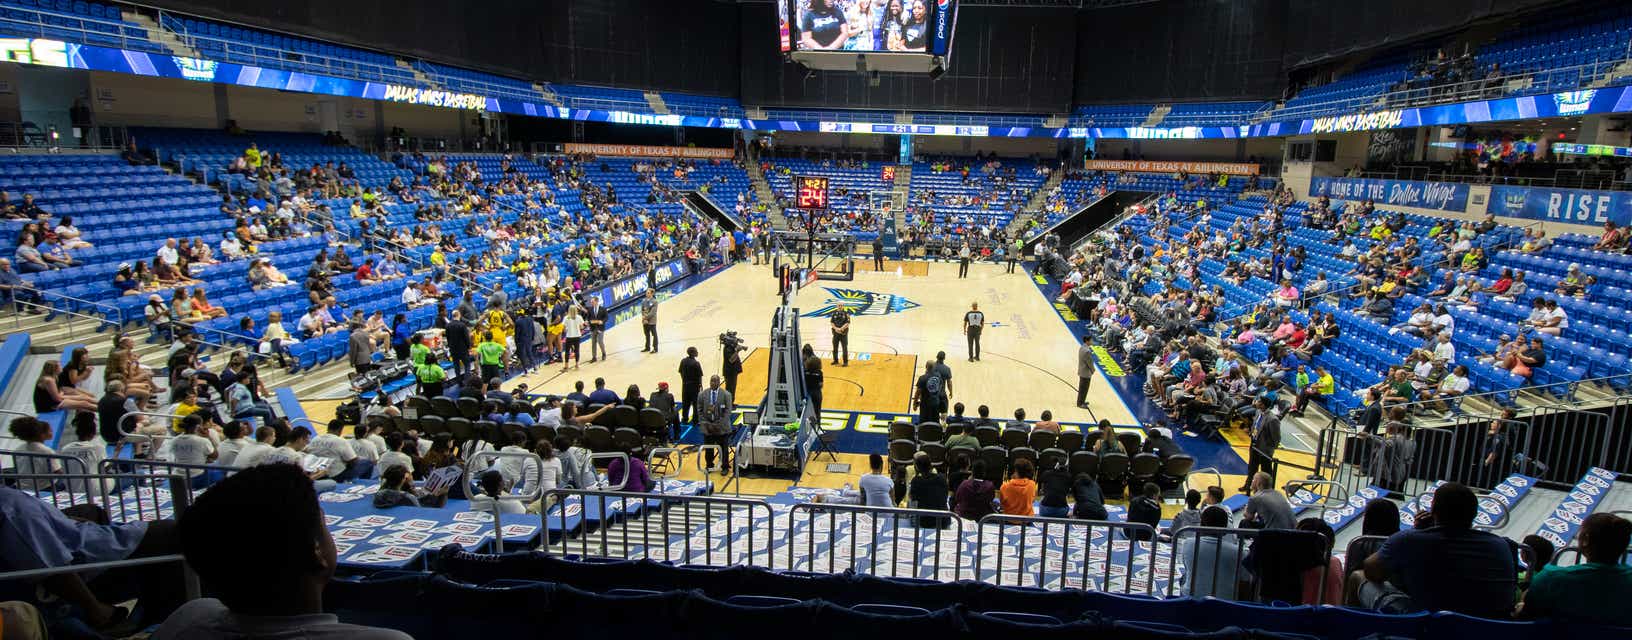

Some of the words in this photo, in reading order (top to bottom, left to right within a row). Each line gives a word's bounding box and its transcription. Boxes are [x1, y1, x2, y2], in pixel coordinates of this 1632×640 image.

[384, 84, 418, 104] DALLAS
[444, 91, 487, 110] BASKETBALL
[1311, 117, 1335, 133] DALLAS
[1354, 109, 1402, 131] BASKETBALL
[575, 144, 627, 154] UNIVERSITY
[630, 146, 641, 155] OF
[644, 147, 668, 156] TEXAS
[671, 148, 681, 156] AT
[684, 148, 727, 158] ARLINGTON
[883, 171, 894, 179] 24
[1093, 161, 1136, 170] UNIVERSITY
[1139, 162, 1149, 170] OF
[1152, 162, 1178, 171] TEXAS
[1181, 163, 1191, 171] AT
[1194, 163, 1249, 173] ARLINGTON
[804, 179, 826, 189] 4:21
[801, 189, 822, 206] 24
[1330, 183, 1351, 197] HOME
[1353, 184, 1363, 197] OF
[1367, 185, 1385, 200] THE
[1388, 183, 1421, 204] Dallas
[1422, 182, 1456, 210] Wings
[1547, 192, 1611, 223] RISE
